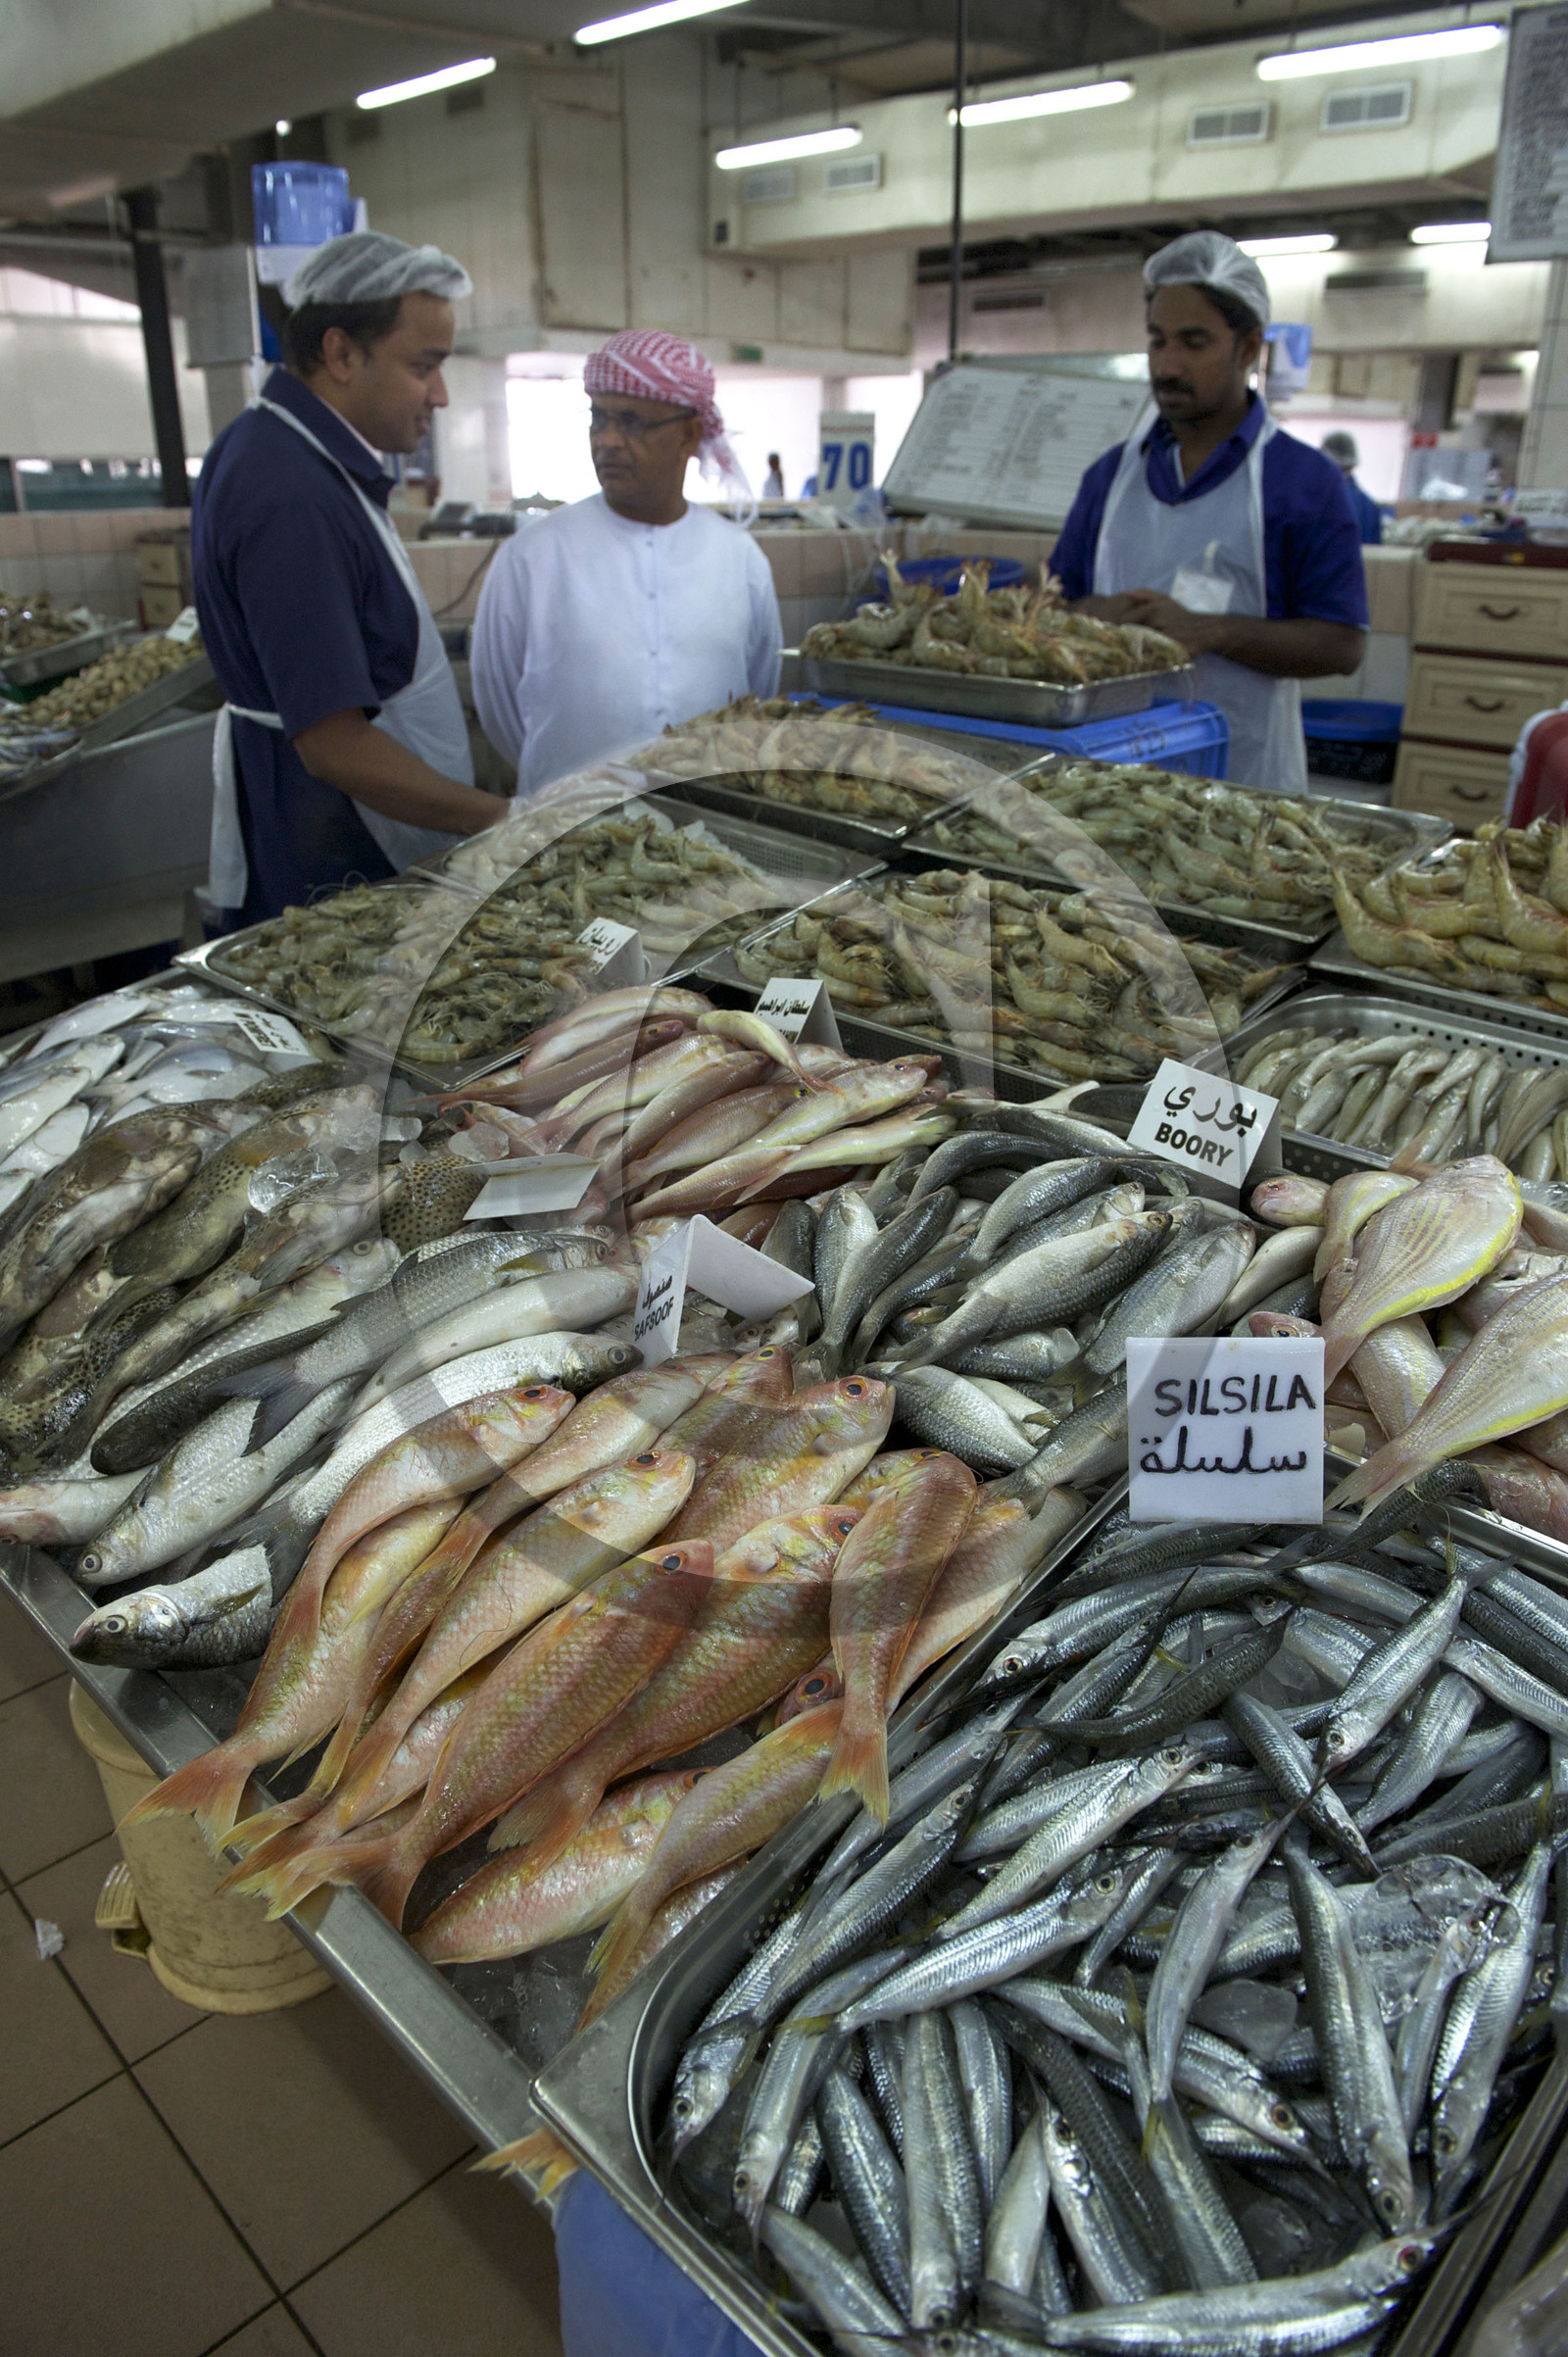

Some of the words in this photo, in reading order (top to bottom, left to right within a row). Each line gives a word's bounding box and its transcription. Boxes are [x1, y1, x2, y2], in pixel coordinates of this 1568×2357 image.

[822, 442, 870, 491] 70
[1163, 1086, 1257, 1138] بوري
[1153, 1121, 1234, 1167] BOORY
[634, 1296, 674, 1342] SAFSOOF
[1154, 1374, 1317, 1417] SILSILA
[1140, 1425, 1307, 1475] سلسلة
